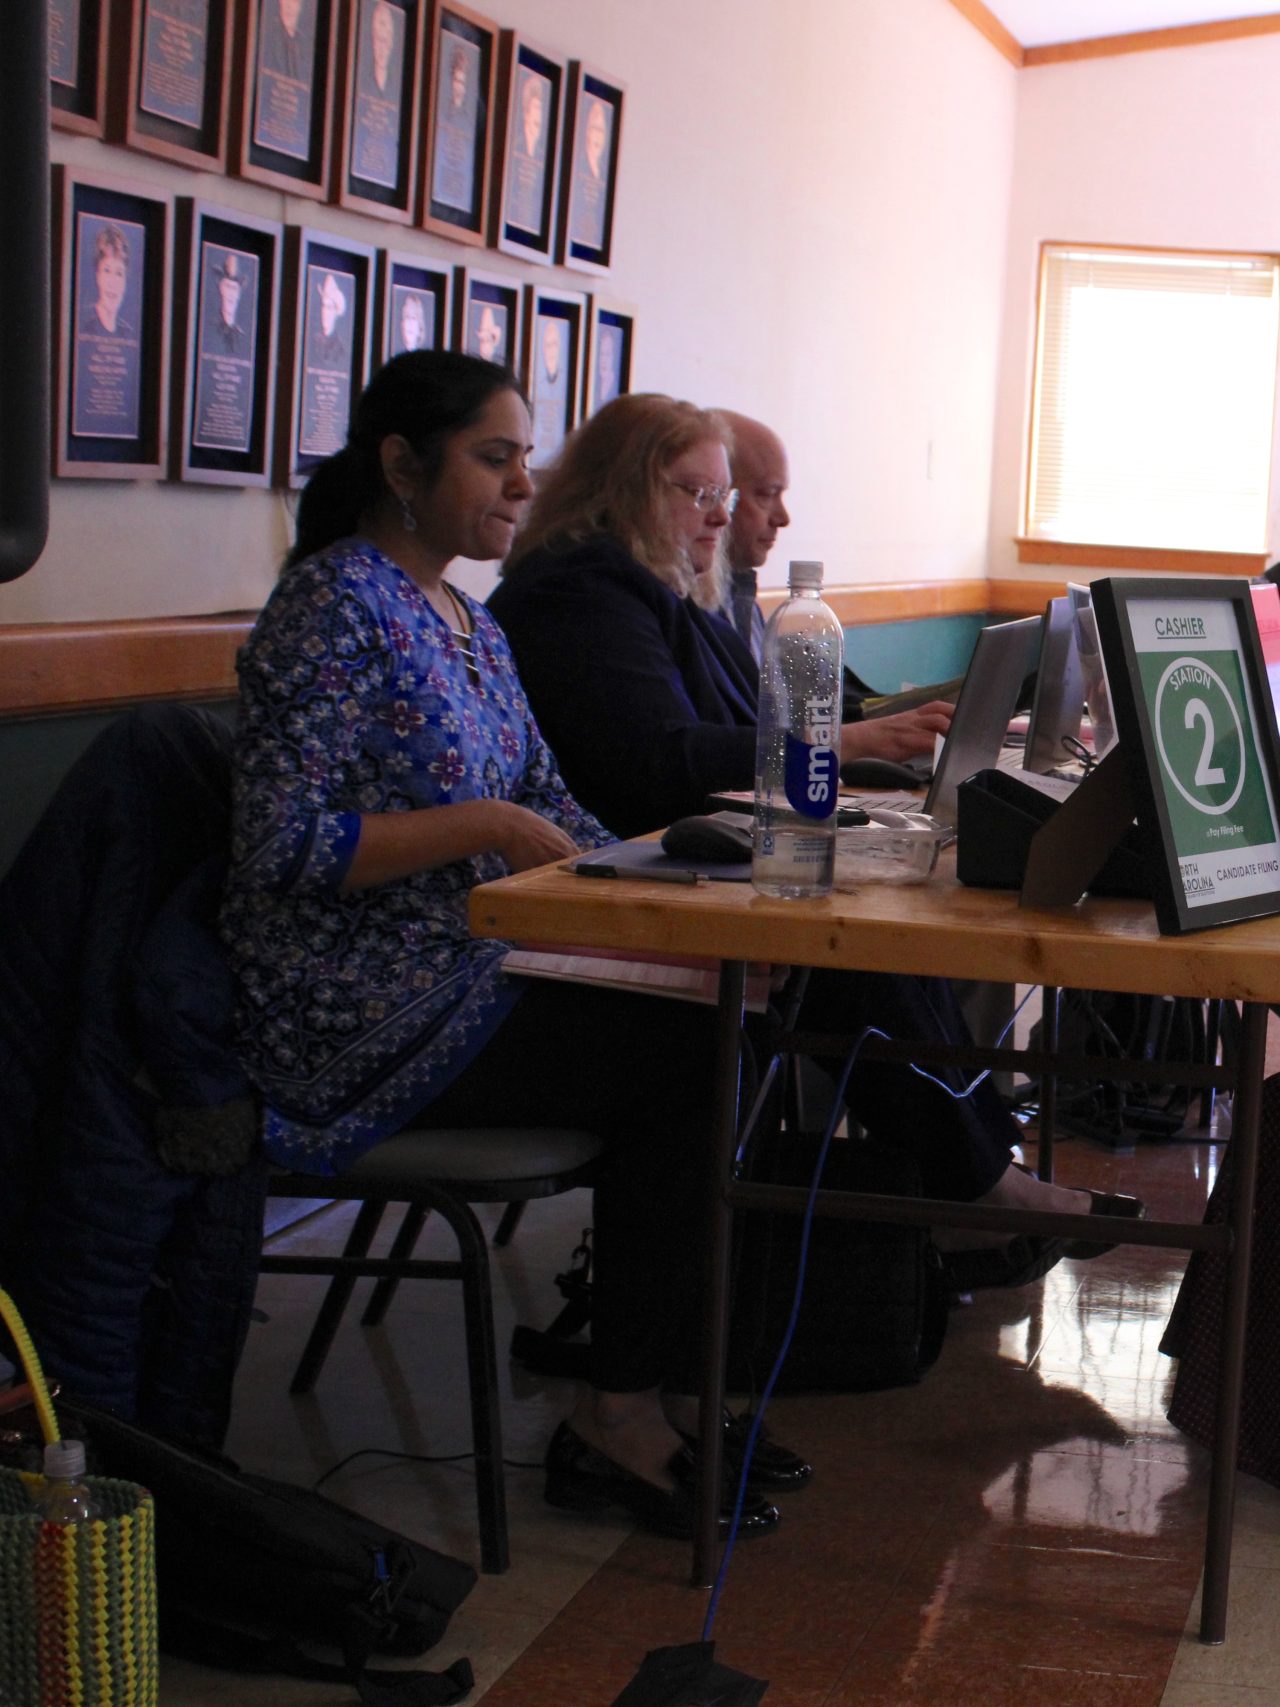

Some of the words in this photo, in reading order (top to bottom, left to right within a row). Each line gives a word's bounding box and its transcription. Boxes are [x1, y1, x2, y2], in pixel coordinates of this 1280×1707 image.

[1155, 617, 1206, 636] CASHIER
[1169, 667, 1212, 691] STATION
[807, 695, 833, 802] smart
[1184, 698, 1226, 786] 2
[1234, 825, 1244, 833] Fee
[1216, 865, 1257, 881] CANDIDATE
[1258, 861, 1279, 873] FILING
[1184, 876, 1214, 891] AROLINA
